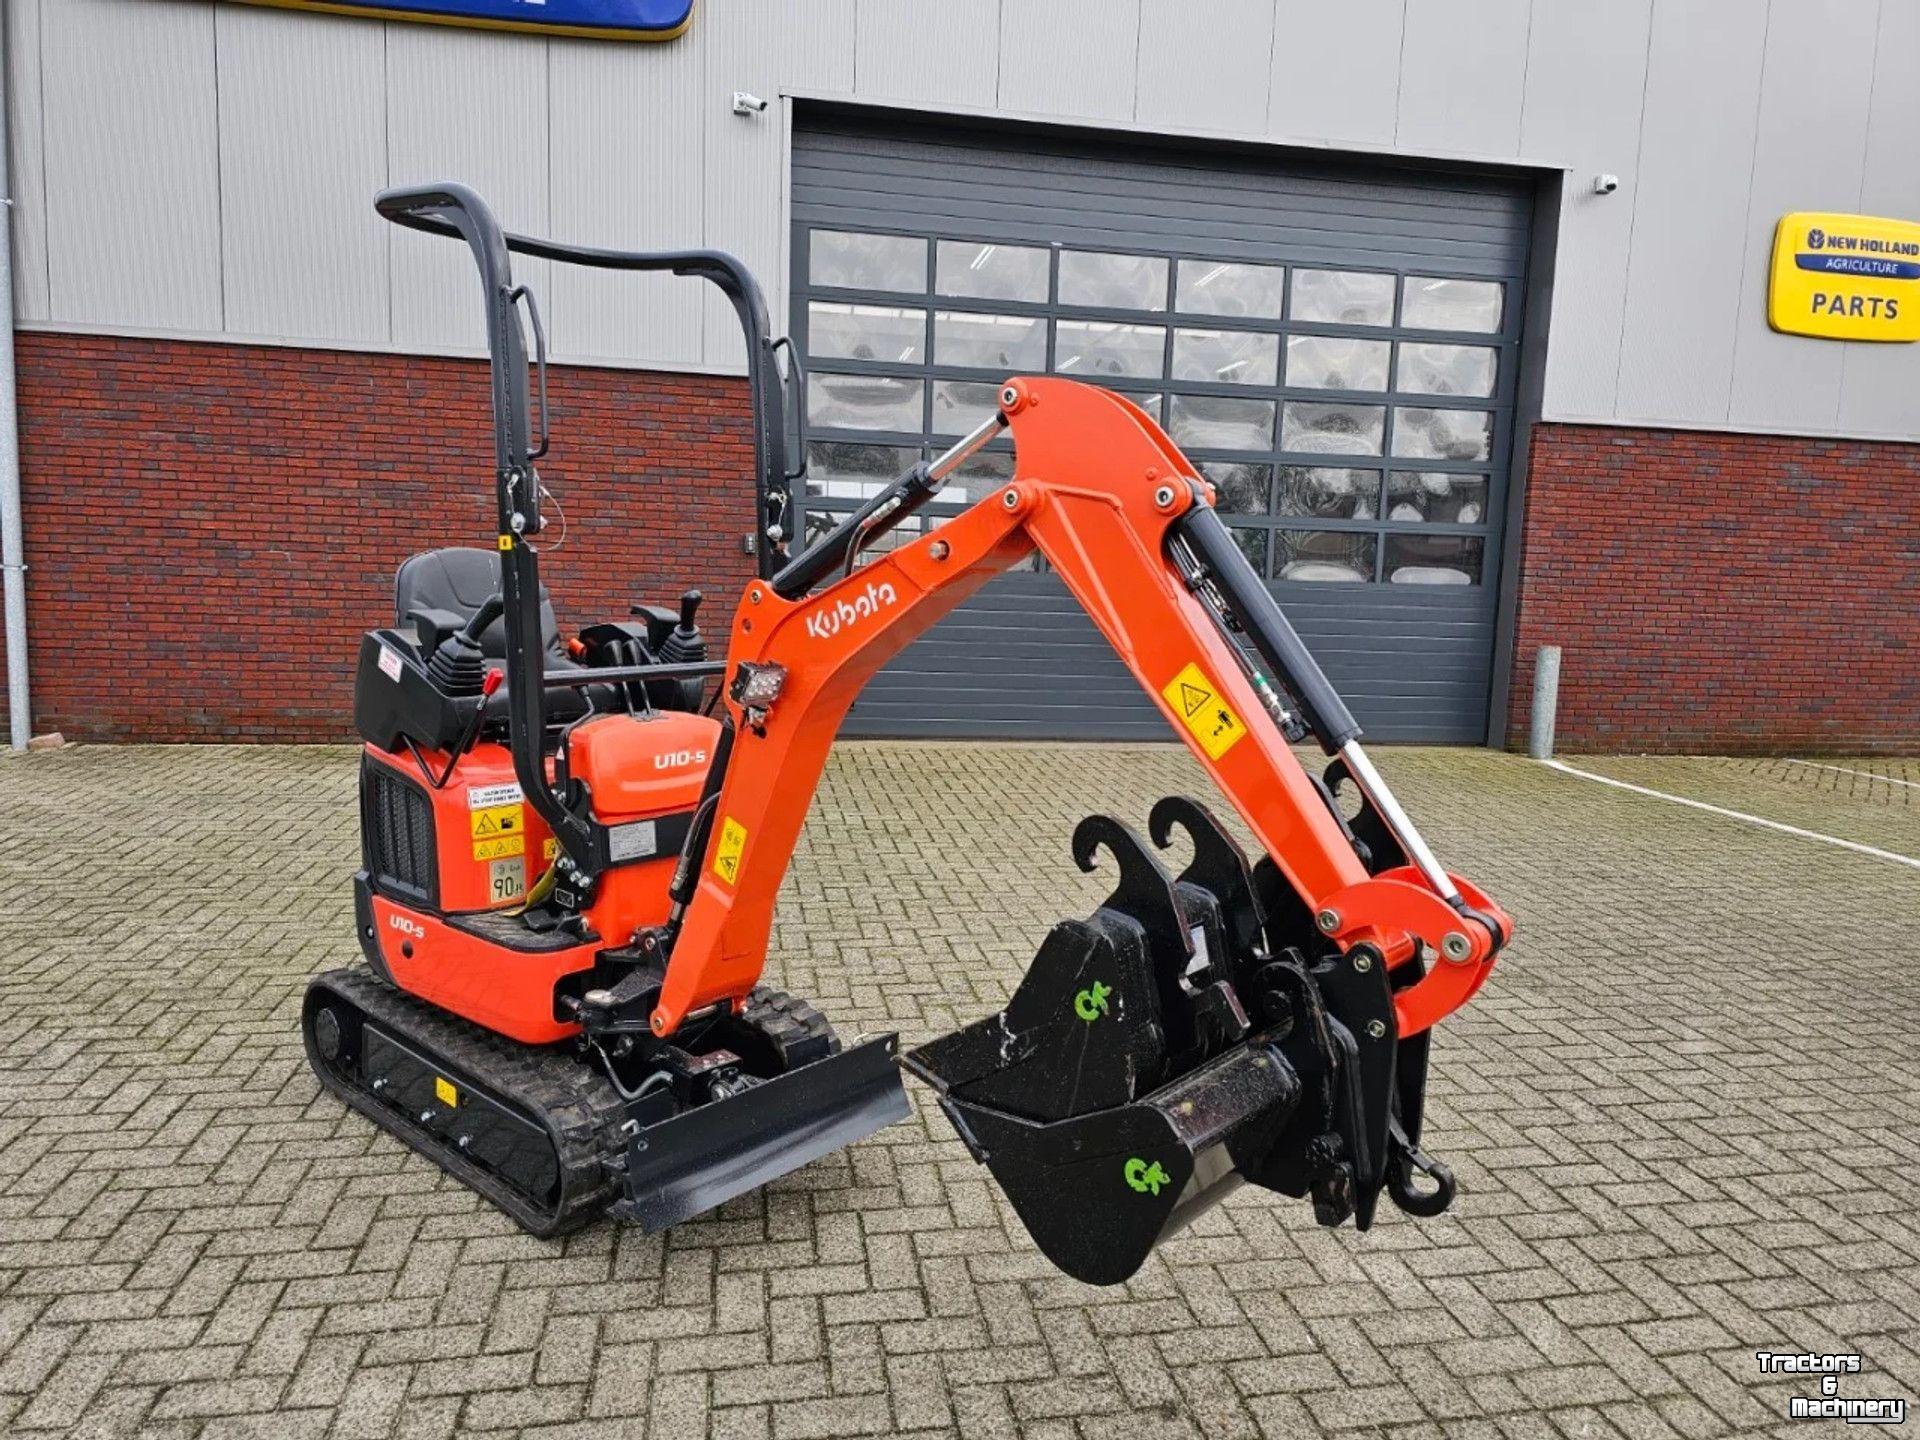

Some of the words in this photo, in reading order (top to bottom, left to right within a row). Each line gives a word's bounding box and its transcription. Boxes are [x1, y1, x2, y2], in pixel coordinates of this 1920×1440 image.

[1827, 234, 1857, 251] NEW
[1859, 238, 1920, 257] HOLLAND
[1825, 257, 1899, 275] AGRICULTURE
[1811, 292, 1899, 320] PARTS
[805, 582, 898, 639] Kubota
